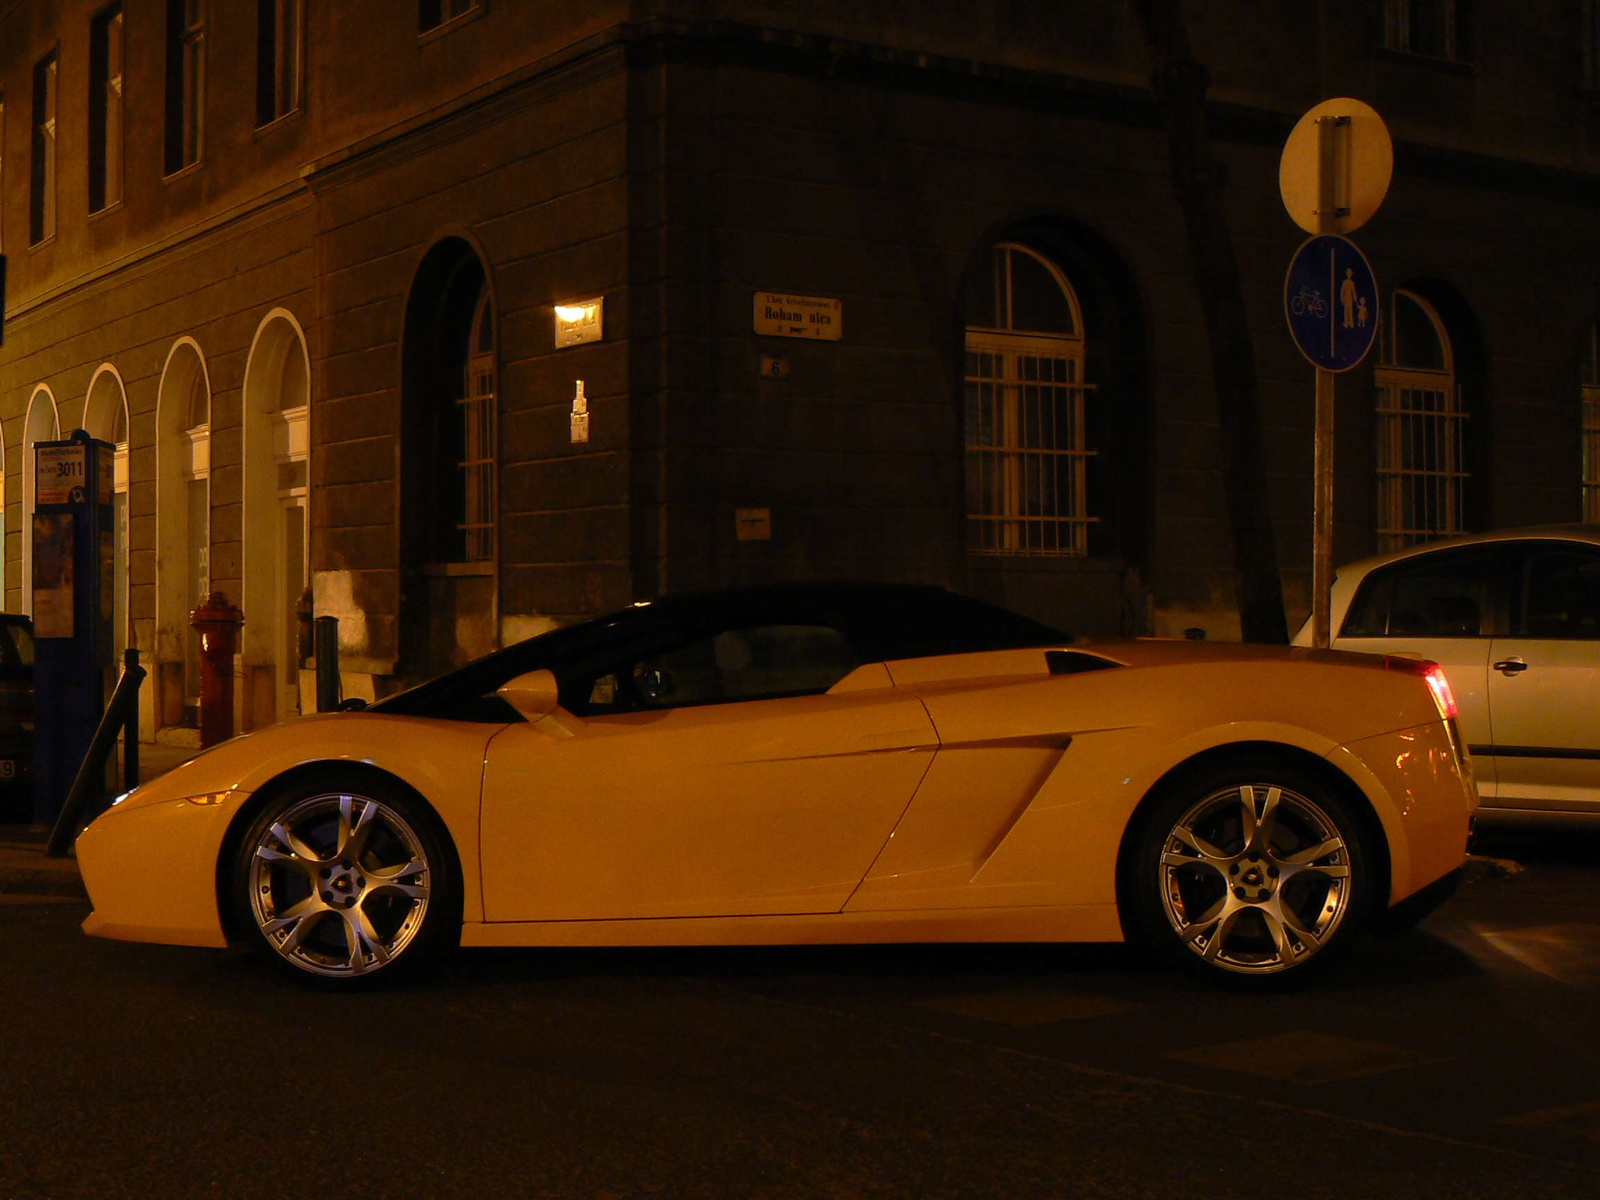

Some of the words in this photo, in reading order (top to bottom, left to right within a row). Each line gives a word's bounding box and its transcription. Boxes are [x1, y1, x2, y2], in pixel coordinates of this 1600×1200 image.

[765, 306, 802, 322] Roham
[772, 361, 780, 376] 6
[57, 461, 83, 478] 3011
